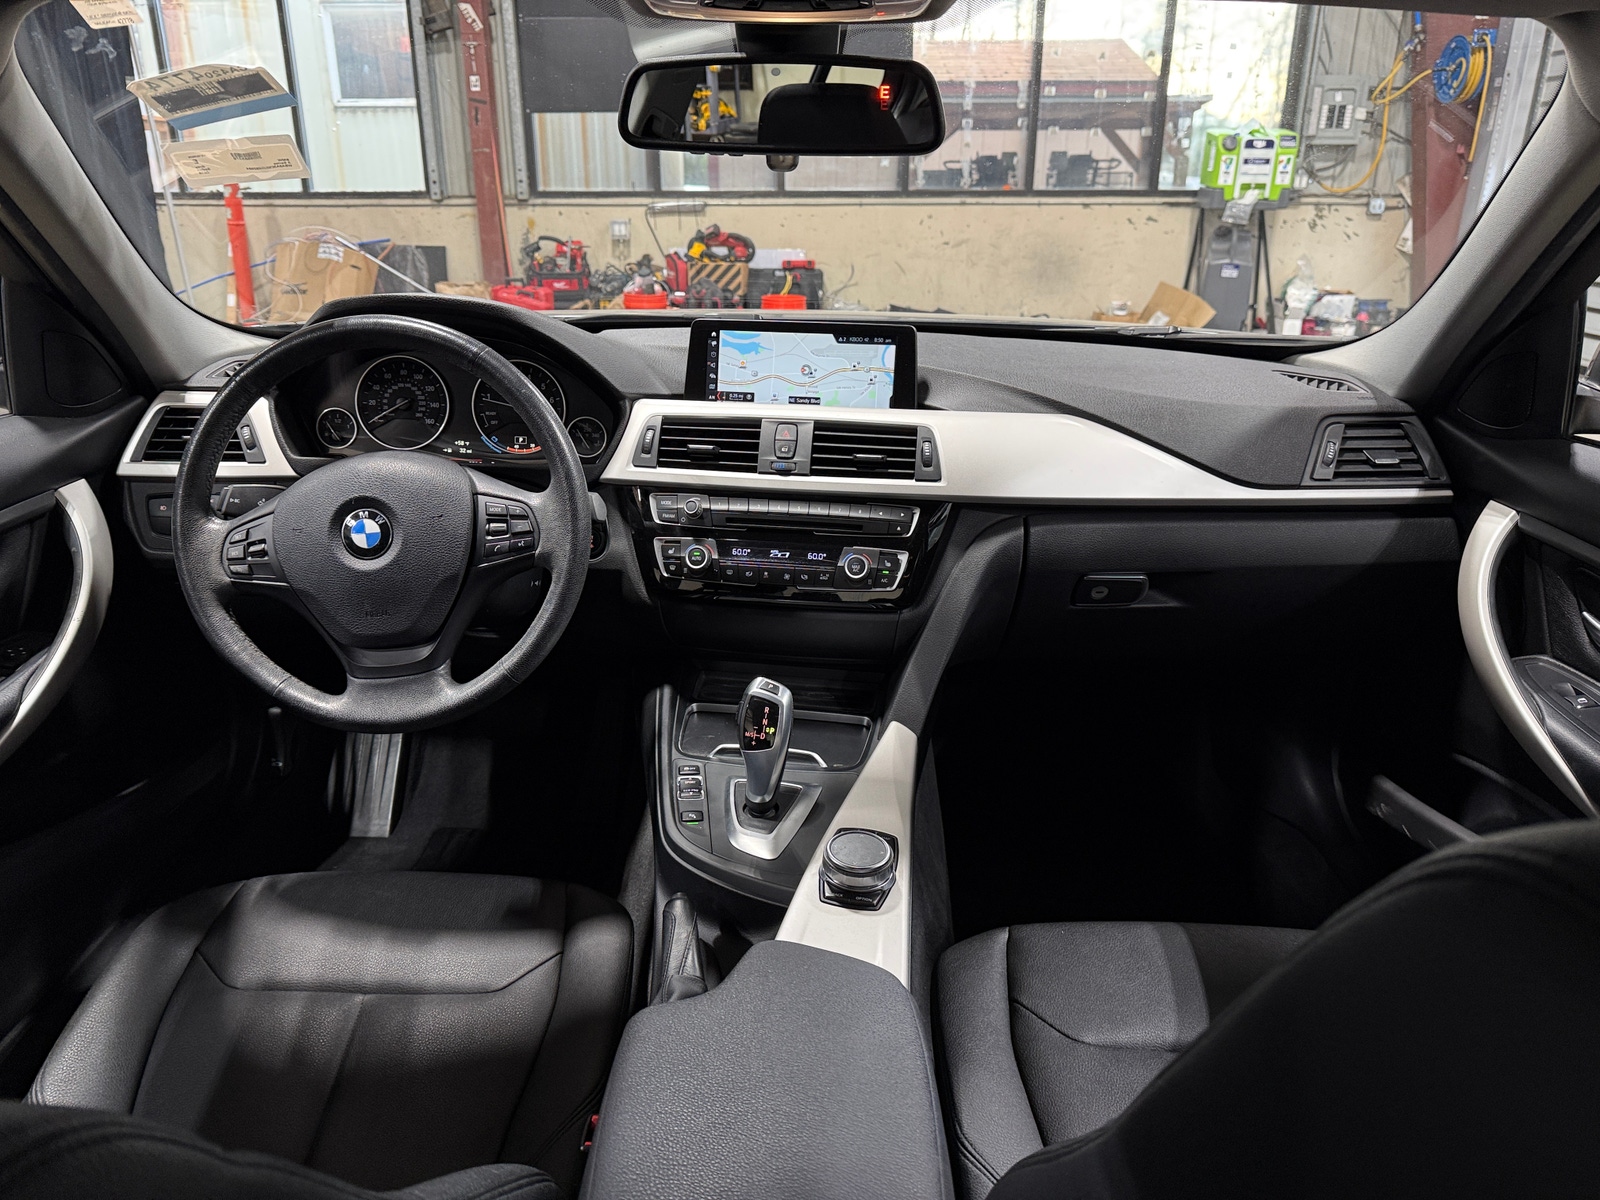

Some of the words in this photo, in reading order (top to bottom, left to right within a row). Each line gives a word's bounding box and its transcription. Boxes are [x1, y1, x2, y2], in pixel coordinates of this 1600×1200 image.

[880, 85, 890, 99] E
[345, 510, 386, 528] BMW
[760, 732, 766, 740] D
